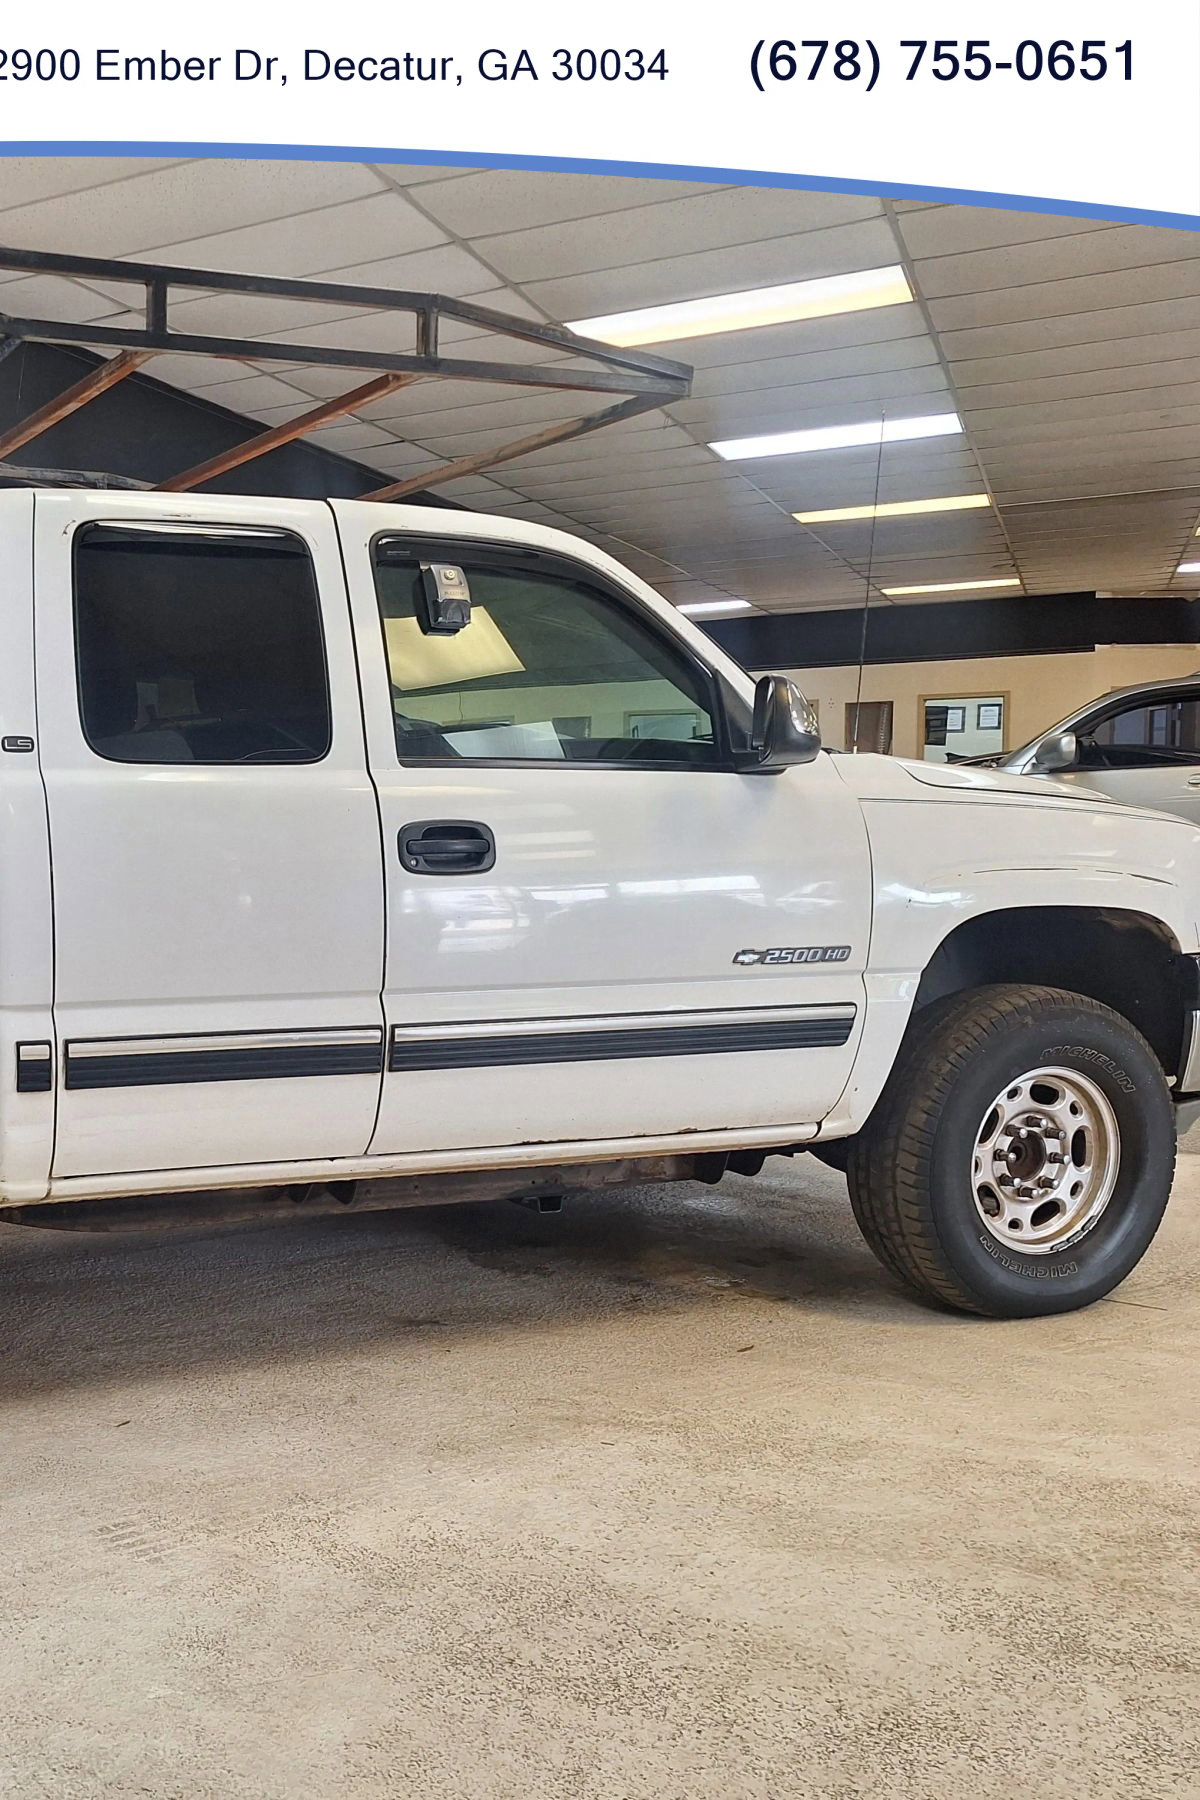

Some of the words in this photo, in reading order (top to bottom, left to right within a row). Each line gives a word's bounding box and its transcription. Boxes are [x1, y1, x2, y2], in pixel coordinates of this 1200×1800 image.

[4, 739, 32, 750] LS
[764, 948, 820, 964] 2500
[825, 948, 850, 961] HD
[1040, 1045, 1137, 1094] MICHELIN
[979, 1233, 1079, 1279] MICHELIN
